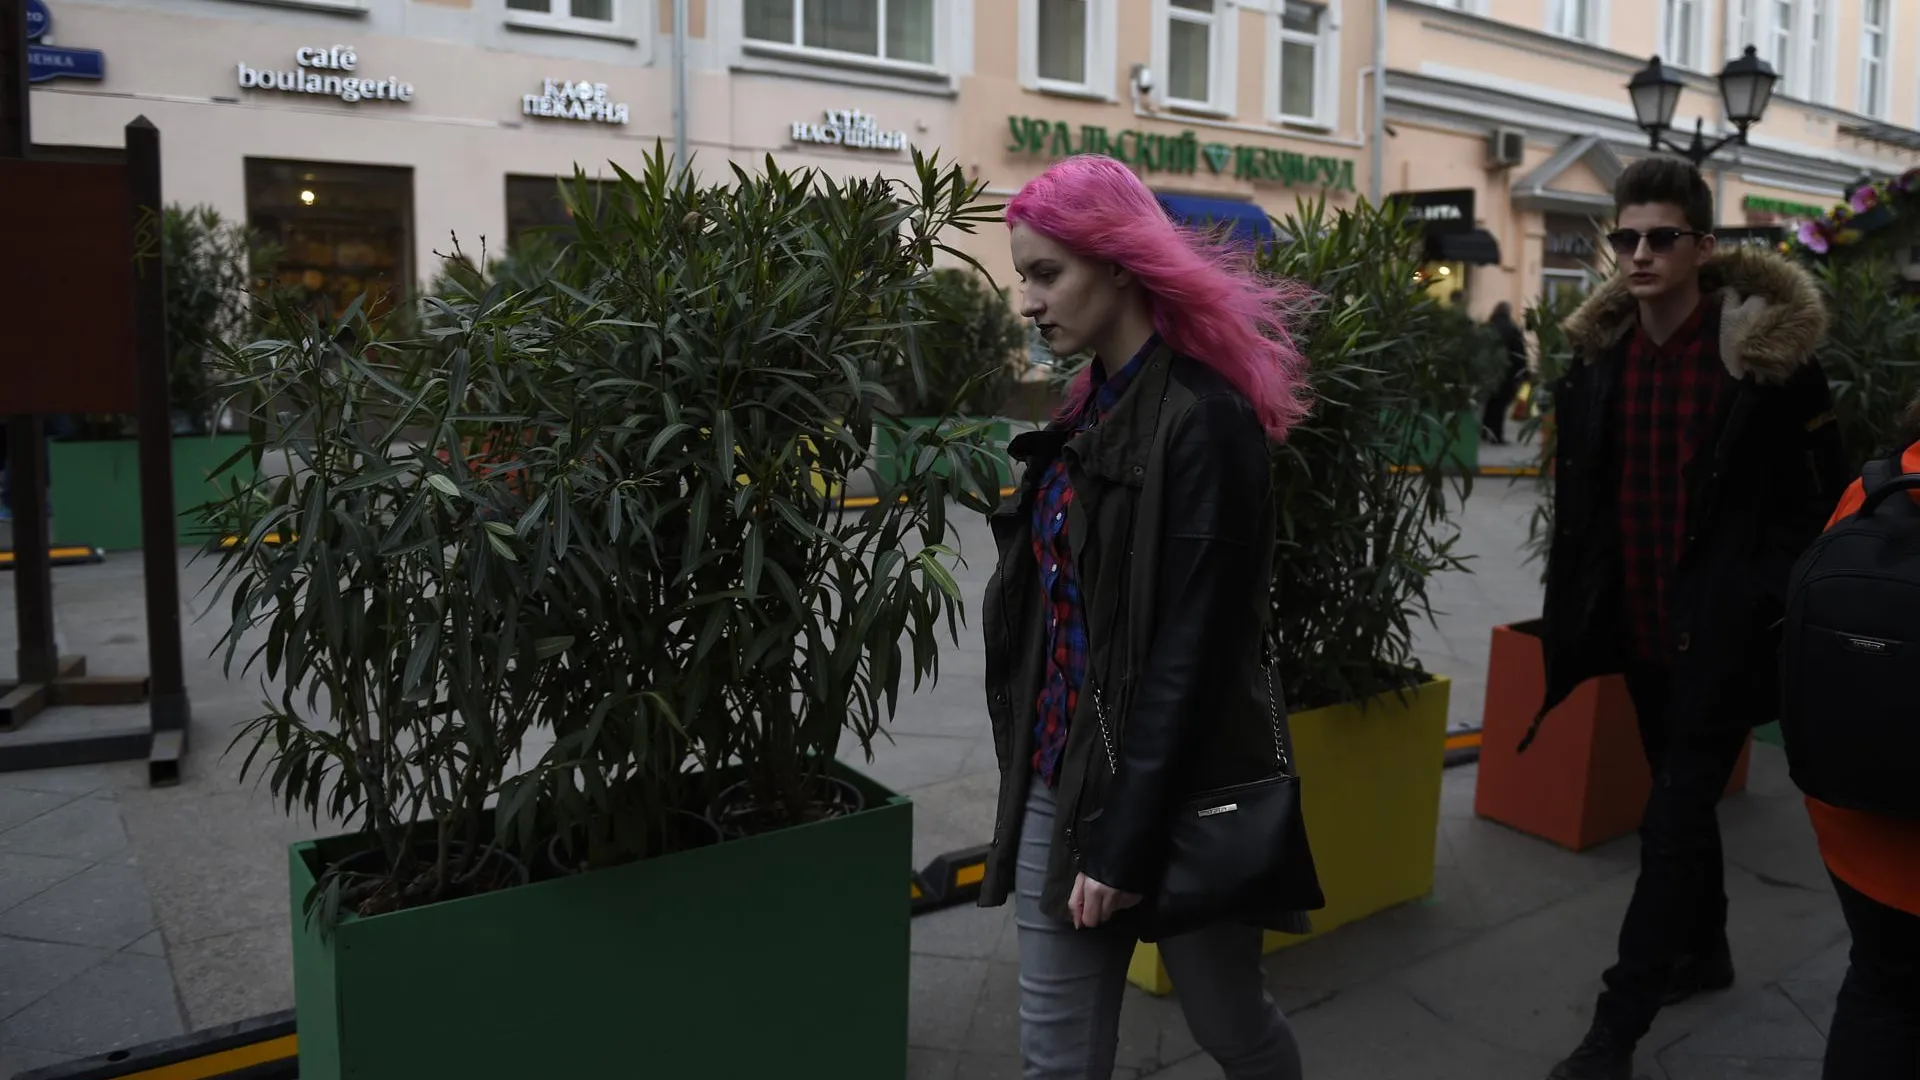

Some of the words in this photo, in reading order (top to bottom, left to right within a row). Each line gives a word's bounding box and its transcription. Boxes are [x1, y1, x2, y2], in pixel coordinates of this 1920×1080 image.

[296, 44, 358, 71] café
[237, 60, 414, 103] boulangerie
[543, 76, 608, 102] КАФЕ
[522, 93, 630, 125] ПЕКАРНЯ
[1006, 114, 1198, 176] УРАЛЬСКИЙ
